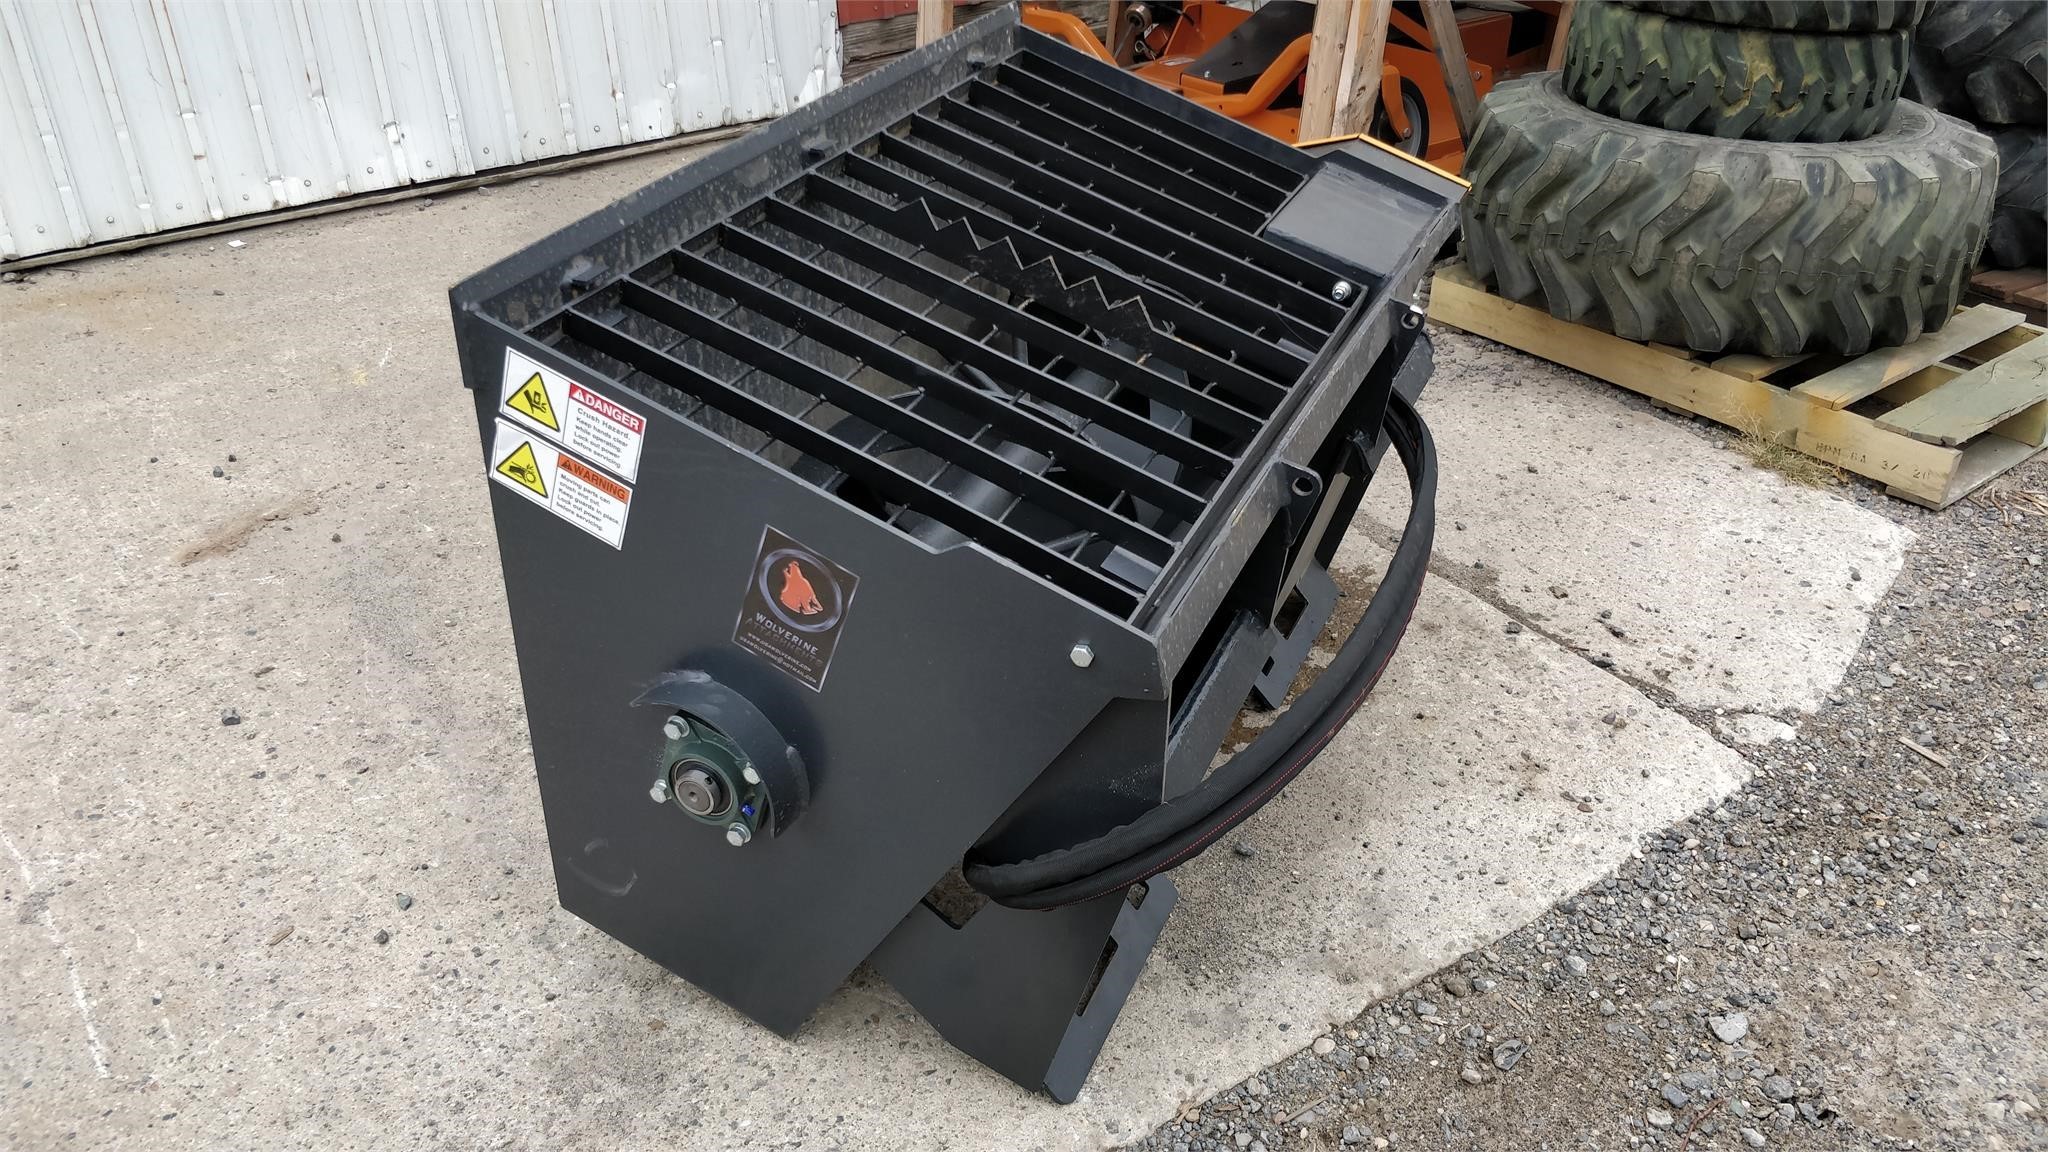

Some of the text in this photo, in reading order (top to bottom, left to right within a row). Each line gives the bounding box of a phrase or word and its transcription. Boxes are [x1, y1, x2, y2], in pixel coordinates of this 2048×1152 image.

[578, 408, 631, 441] Crush Hazard.
[585, 393, 640, 431] DANGER
[575, 425, 591, 436] while
[576, 417, 628, 447] Keep hands clear
[573, 439, 592, 452] before
[574, 432, 620, 459] Lock out power
[560, 474, 611, 505] Moving parts can
[560, 482, 576, 493] crush
[577, 491, 589, 500] and
[574, 462, 626, 500] WARNING
[556, 501, 575, 515] before
[558, 488, 574, 500] Keep
[574, 497, 595, 512] guards
[596, 508, 602, 516] in
[558, 494, 602, 523] Lock out power
[756, 612, 819, 656] WOLVERINE
